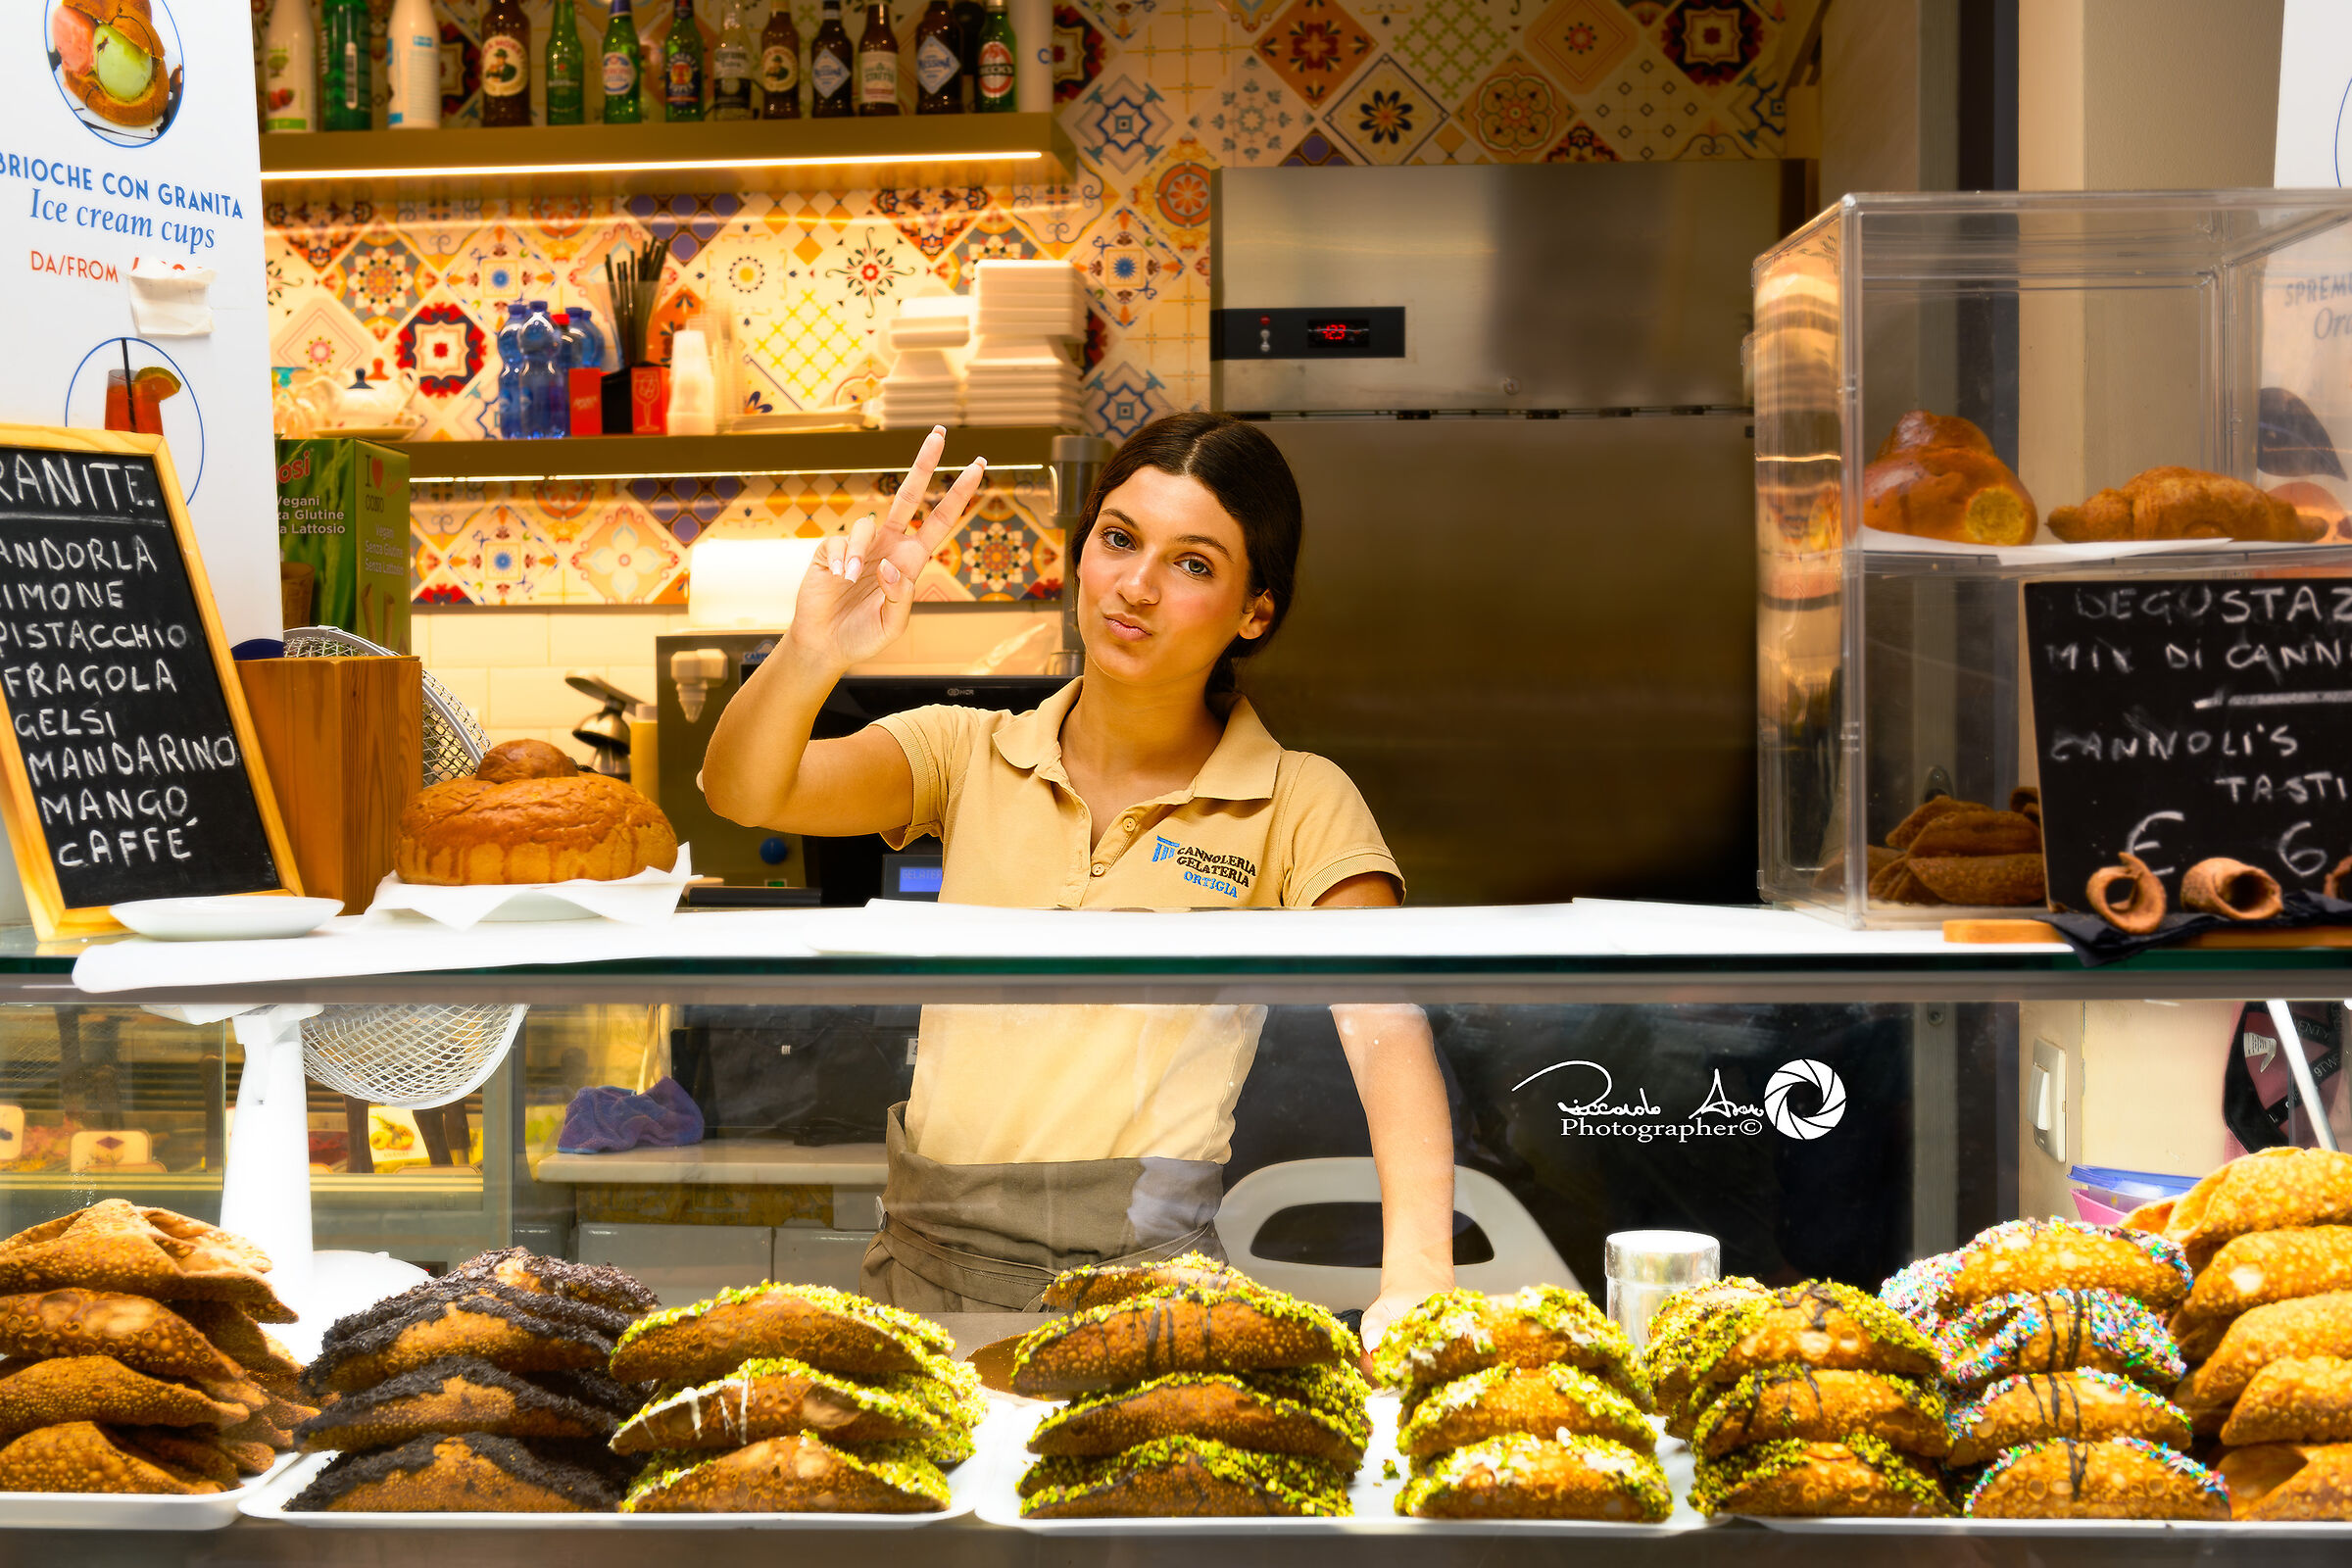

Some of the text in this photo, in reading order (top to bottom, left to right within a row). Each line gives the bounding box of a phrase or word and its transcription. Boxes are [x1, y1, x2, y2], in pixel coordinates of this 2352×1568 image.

[0, 152, 243, 219] BRIOCHE CON GRANITA
[29, 187, 215, 255] Ice cream cups
[30, 250, 119, 283] DA/FROM
[291, 523, 346, 534] Lattosio
[295, 510, 345, 520] Glutine
[0, 580, 124, 611] IMONE
[4, 659, 176, 698] FRAGOLA
[15, 709, 116, 740] GELSI
[28, 735, 237, 786] MANDARINO
[41, 786, 187, 825] MANGO
[1176, 845, 1257, 877] CANNOLERIA
[2277, 821, 2328, 878] 6
[1176, 856, 1250, 888] GELATERIA
[1183, 870, 1238, 899] ORTIGIA
